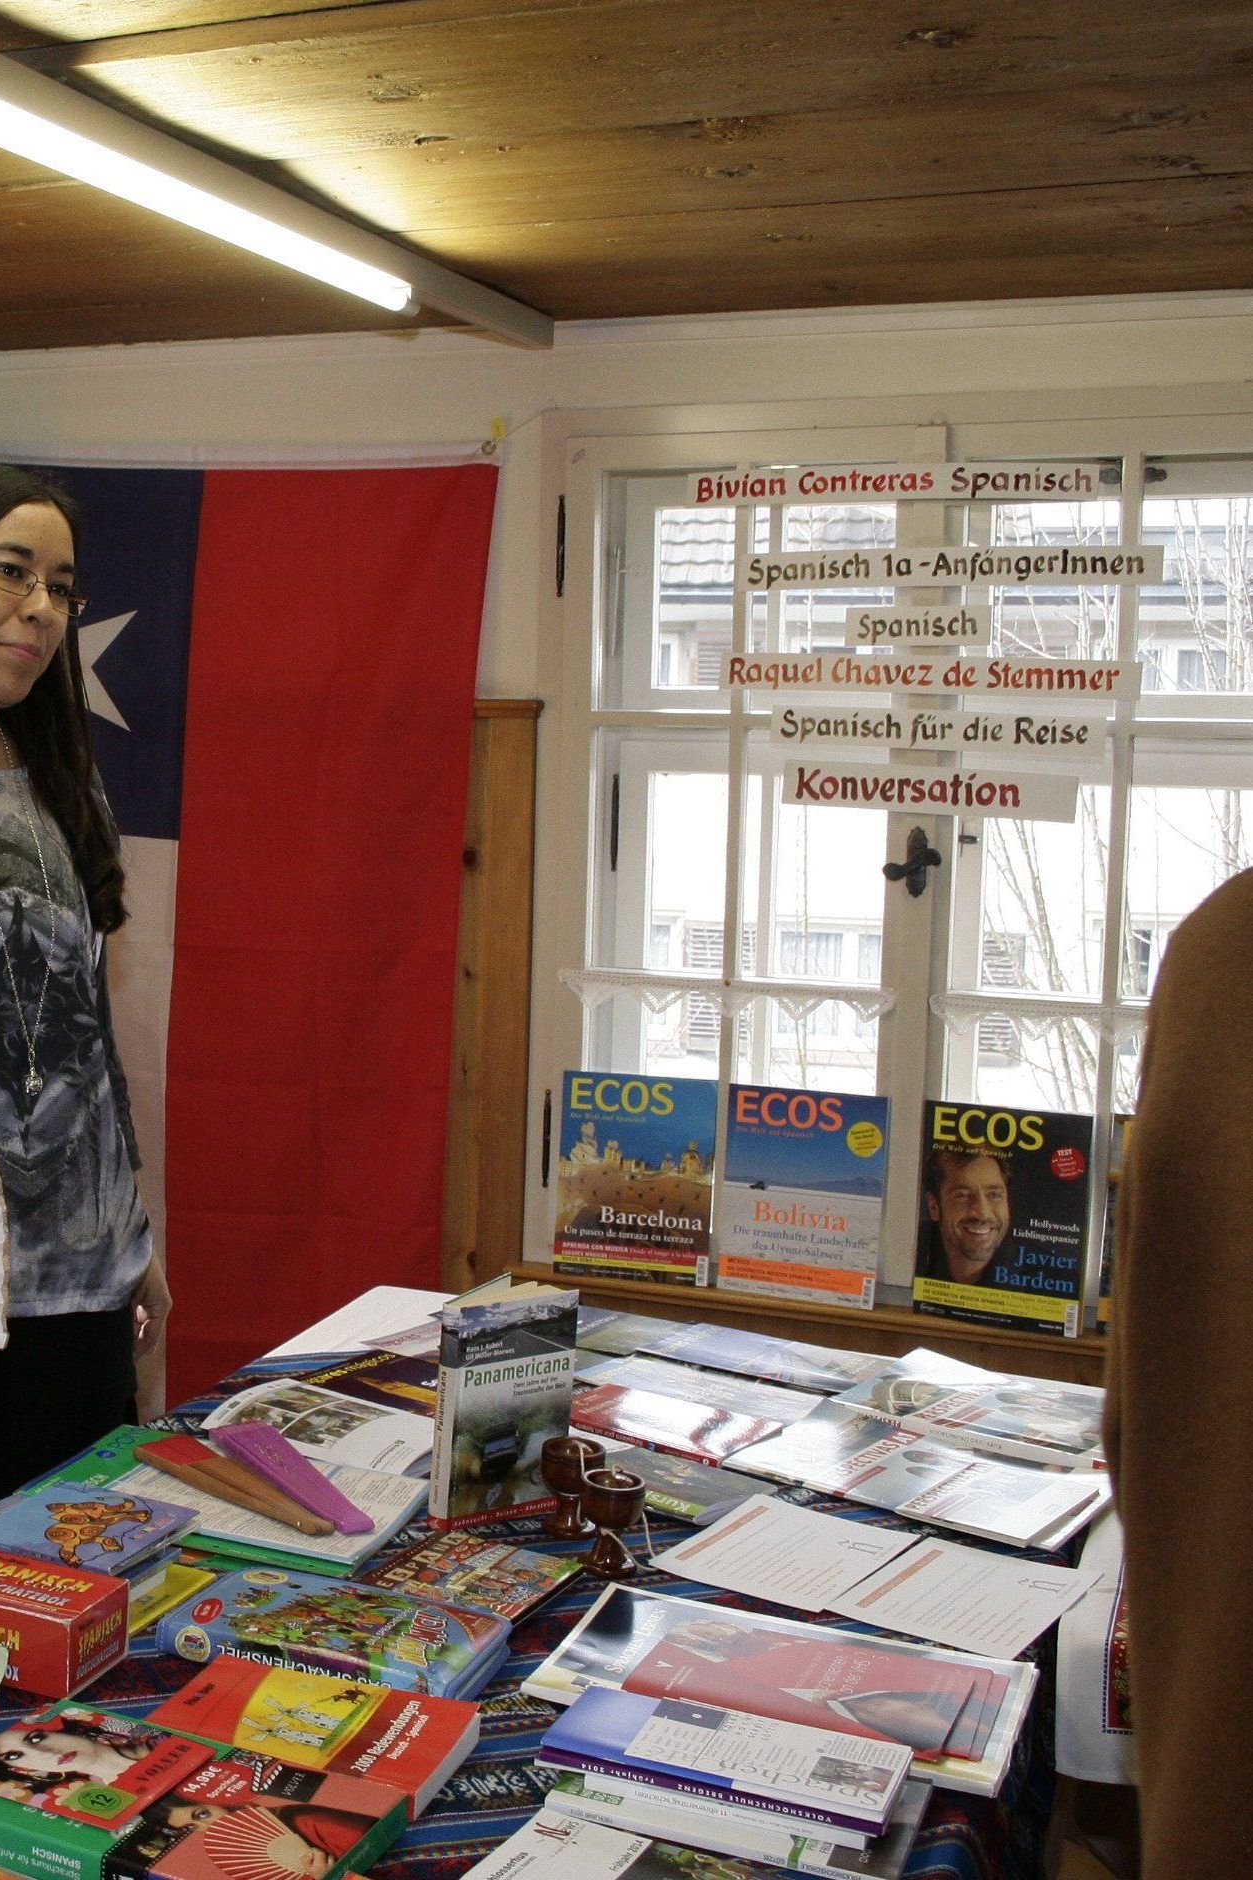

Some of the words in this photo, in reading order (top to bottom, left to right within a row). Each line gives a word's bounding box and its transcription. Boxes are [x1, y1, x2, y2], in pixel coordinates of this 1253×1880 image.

[696, 471, 785, 503] Bivian
[799, 471, 934, 494] Contreras
[950, 466, 1092, 499] Spanisch
[747, 554, 869, 591] Spanisch
[857, 611, 977, 644] Spanisch
[728, 658, 822, 692] Raquel
[943, 660, 975, 687] de
[987, 662, 1120, 691] Stemmer
[780, 710, 902, 741] Spanisch
[910, 713, 953, 748] für
[963, 717, 1003, 743] die
[1014, 719, 1089, 745] Reise
[795, 767, 1021, 808] Konversation
[570, 1077, 674, 1116] ECOS
[736, 1090, 844, 1131] ECOS
[933, 1106, 1044, 1151] ECOS
[1057, 1148, 1073, 1157] TEST
[600, 1205, 702, 1231] Barcelona
[753, 1199, 847, 1232] Bolivia
[1029, 1218, 1080, 1233] Hollywoods
[564, 1225, 577, 1235] Un
[579, 1228, 604, 1238] paseo
[606, 1227, 617, 1237] de
[618, 1230, 648, 1241] terraza
[650, 1233, 662, 1242] en
[663, 1234, 694, 1244] terraza
[733, 1224, 748, 1236] Die
[753, 1226, 807, 1243] traumhafte
[752, 1240, 769, 1251] des
[1012, 1228, 1080, 1246] Lieblingsspanier
[1014, 1246, 1078, 1270] Javier
[994, 1265, 1075, 1294] Bardem
[464, 1357, 570, 1388] Panamericana
[437, 1371, 447, 1432] Panamericana
[78, 1608, 123, 1650] SPANISCH
[351, 1751, 377, 1773] 2000
[373, 1700, 423, 1757] Redewendungen
[407, 1714, 430, 1738] Spanisch
[183, 1765, 223, 1794] 14,99€
[581, 1762, 606, 1774] 2014
[610, 1768, 655, 1785] Frühjahr
[90, 1793, 115, 1808] 12
[205, 1773, 242, 1799] Sprachkurs
[230, 1780, 248, 1796] Film
[677, 1783, 724, 1801] BREGENZ
[725, 1794, 833, 1823] VOLKSHOCHSCHULE
[31, 1845, 83, 1870] SPANISCH
